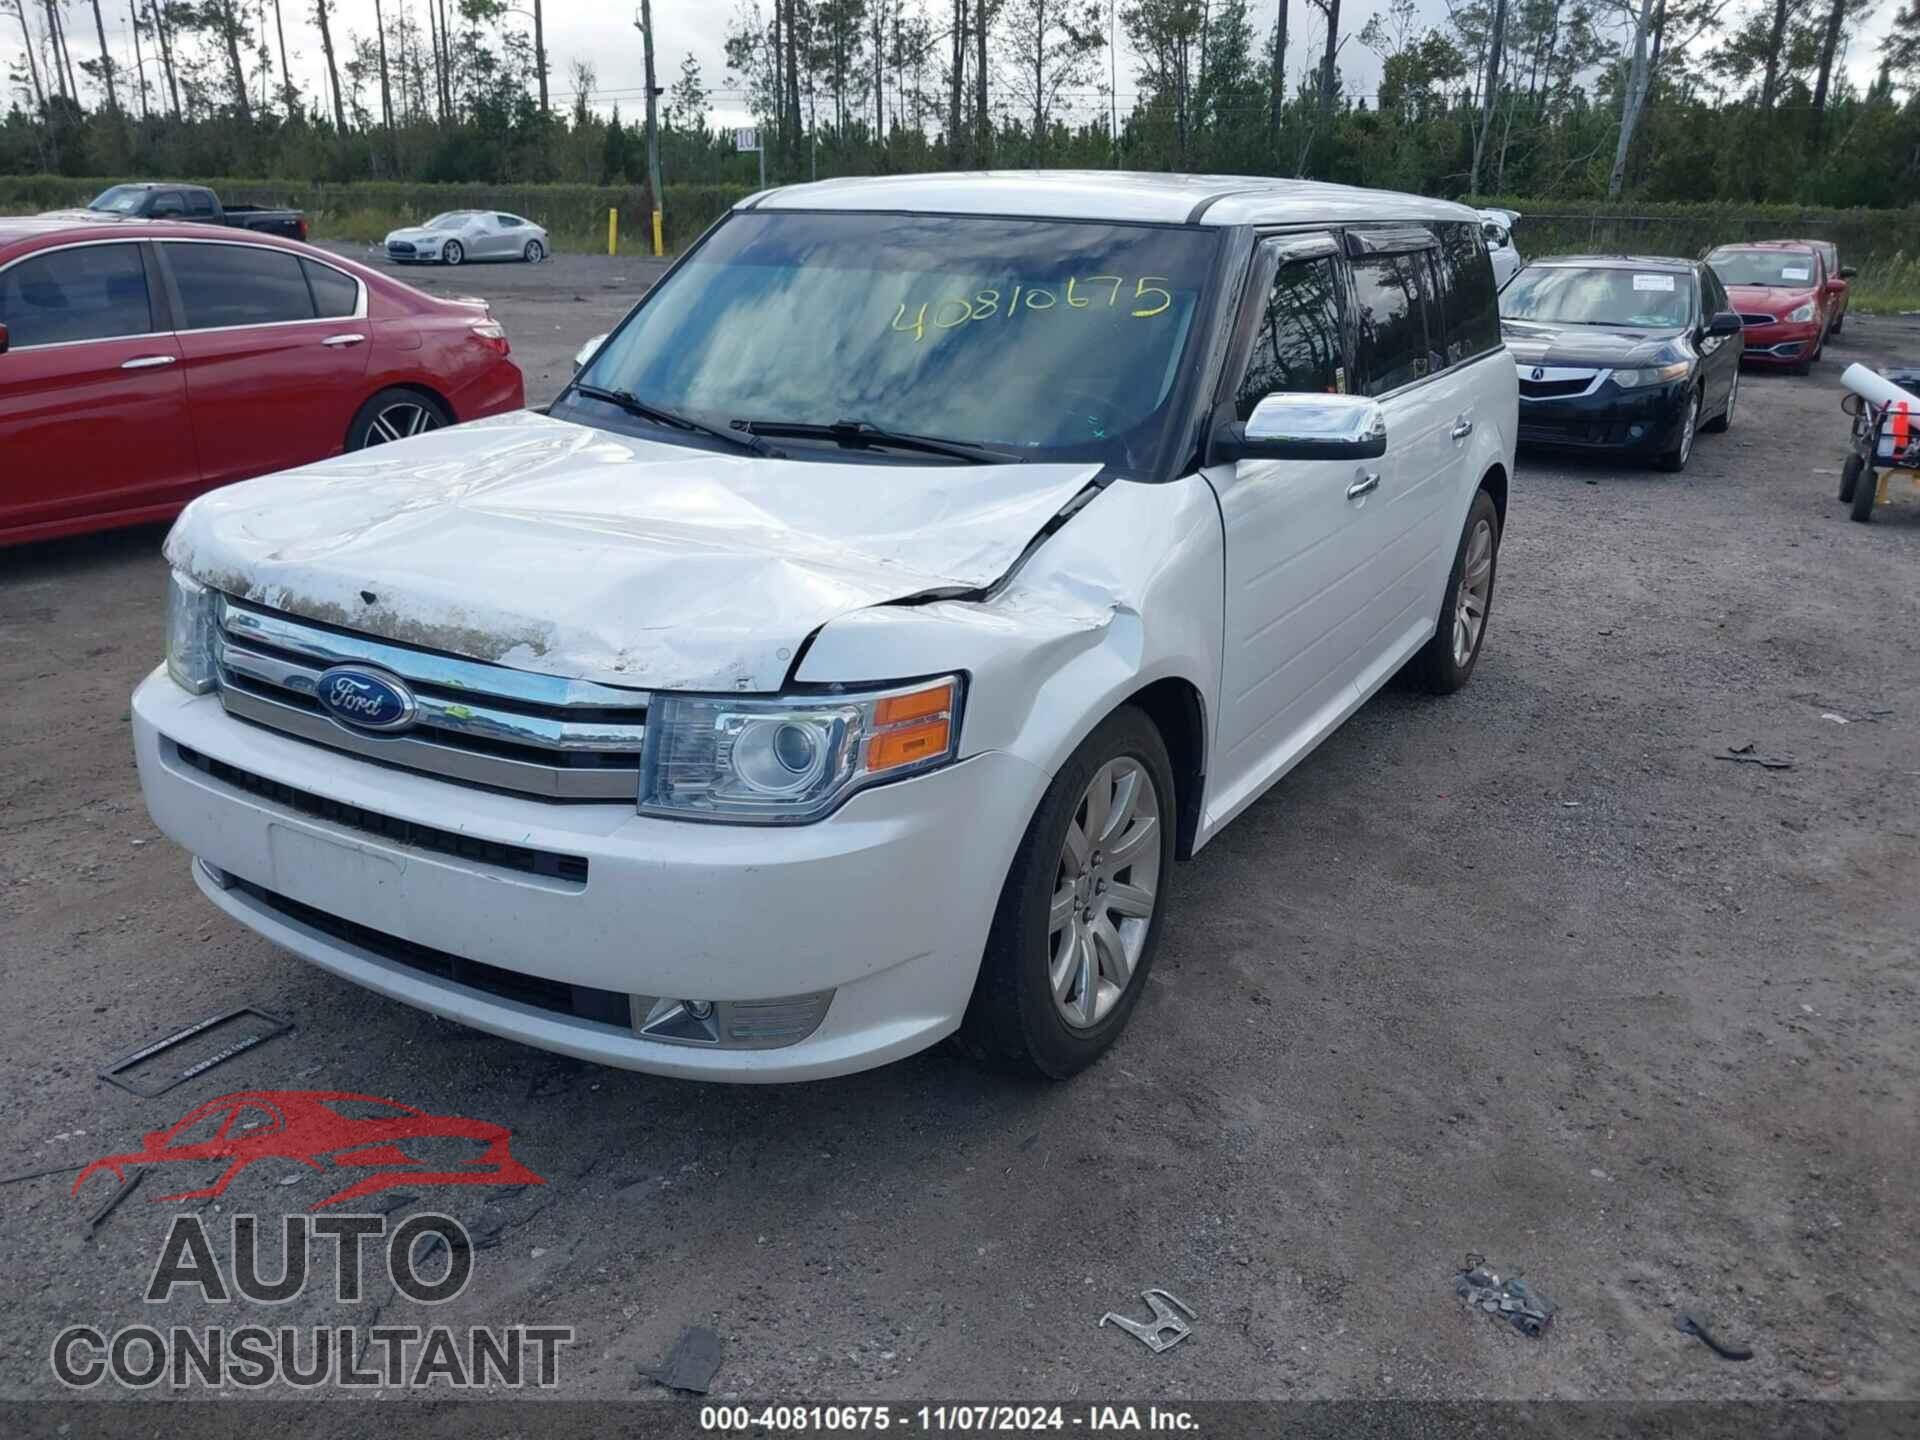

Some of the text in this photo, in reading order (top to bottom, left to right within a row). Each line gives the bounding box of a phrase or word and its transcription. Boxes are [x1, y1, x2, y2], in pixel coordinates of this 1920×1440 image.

[739, 130, 753, 148] 10
[892, 276, 1171, 342] 40810675
[330, 677, 384, 716] Ford
